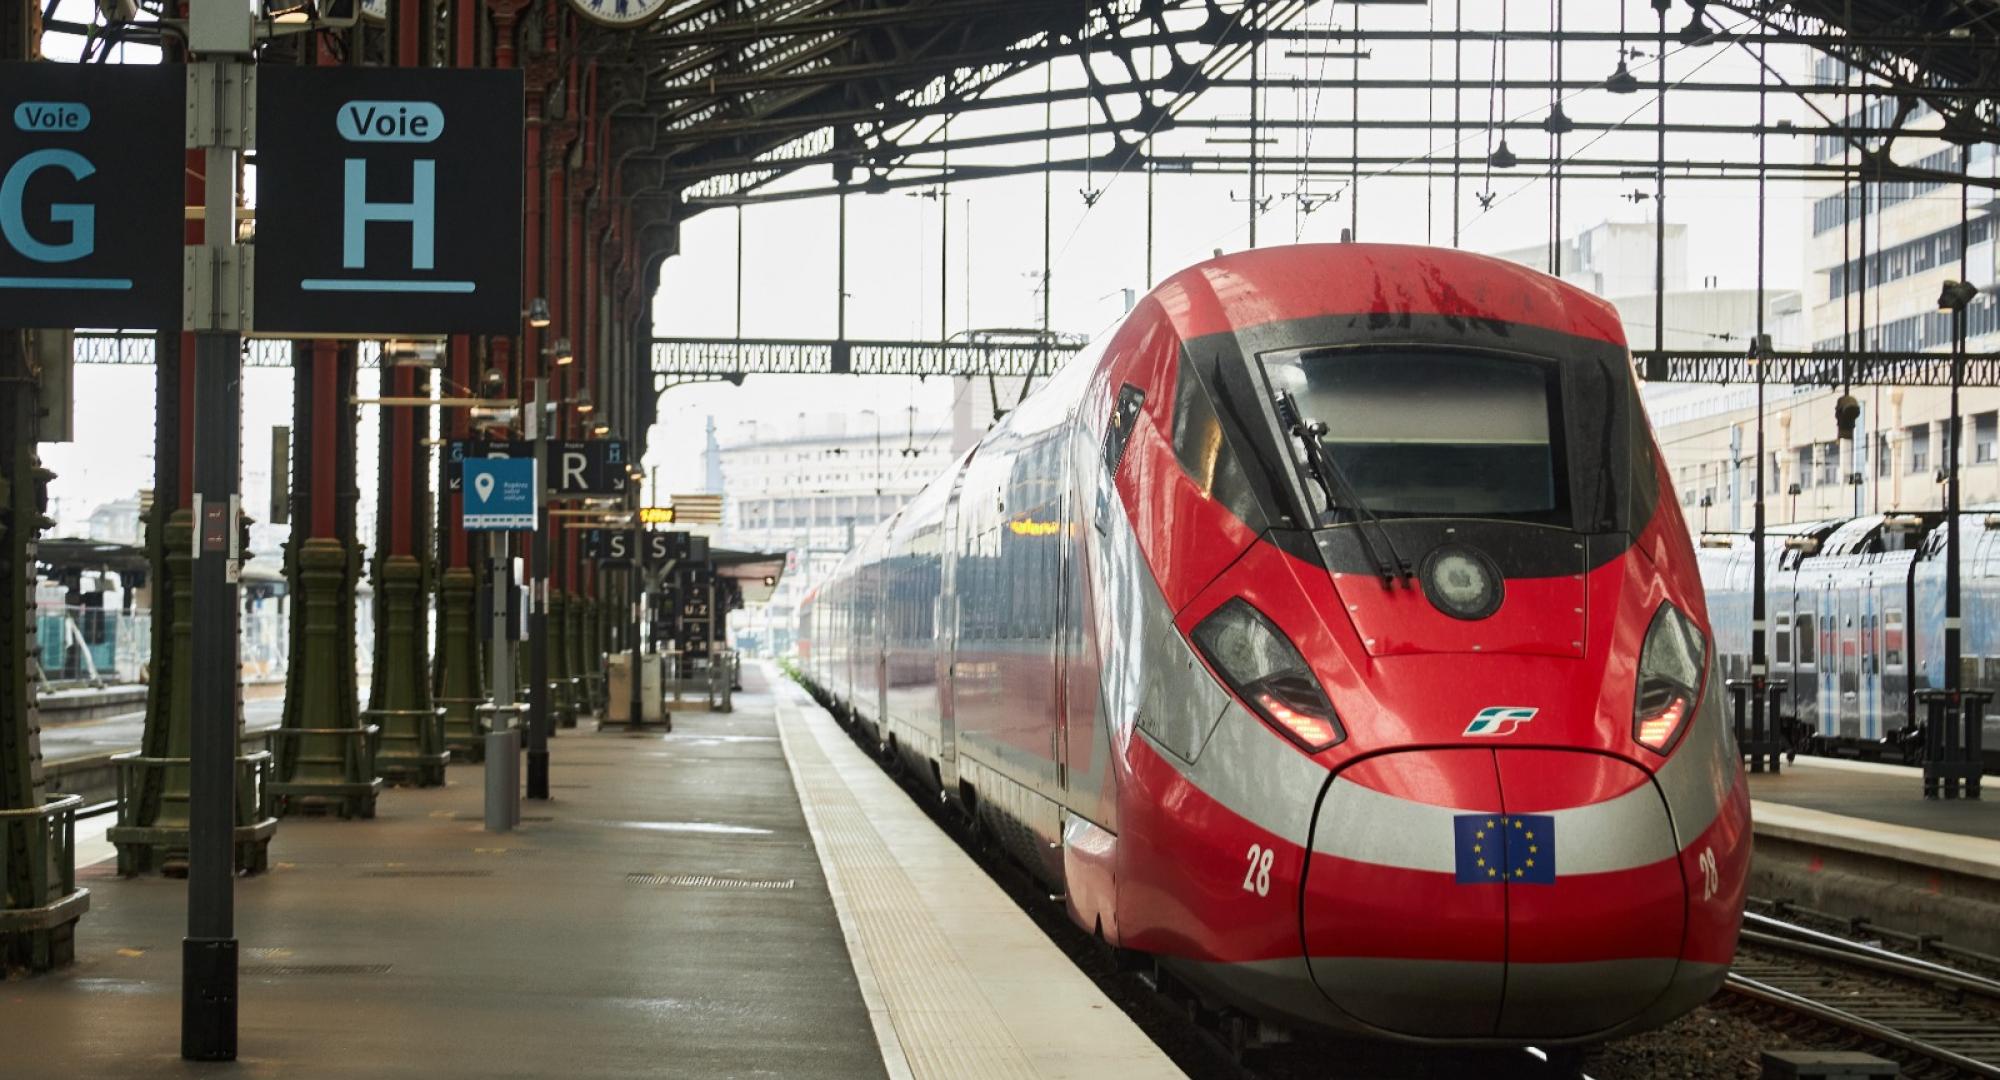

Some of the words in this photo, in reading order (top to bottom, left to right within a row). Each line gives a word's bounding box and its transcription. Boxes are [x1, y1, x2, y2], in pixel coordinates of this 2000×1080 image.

[25, 107, 79, 128] Voie
[350, 106, 429, 136] Voie
[0, 148, 97, 262] G
[343, 158, 435, 269] H
[562, 452, 589, 490] R
[609, 449, 620, 461] H
[610, 535, 626, 558] S
[652, 536, 667, 559] S
[1243, 843, 1275, 898] 28
[1699, 846, 1719, 902] 28
